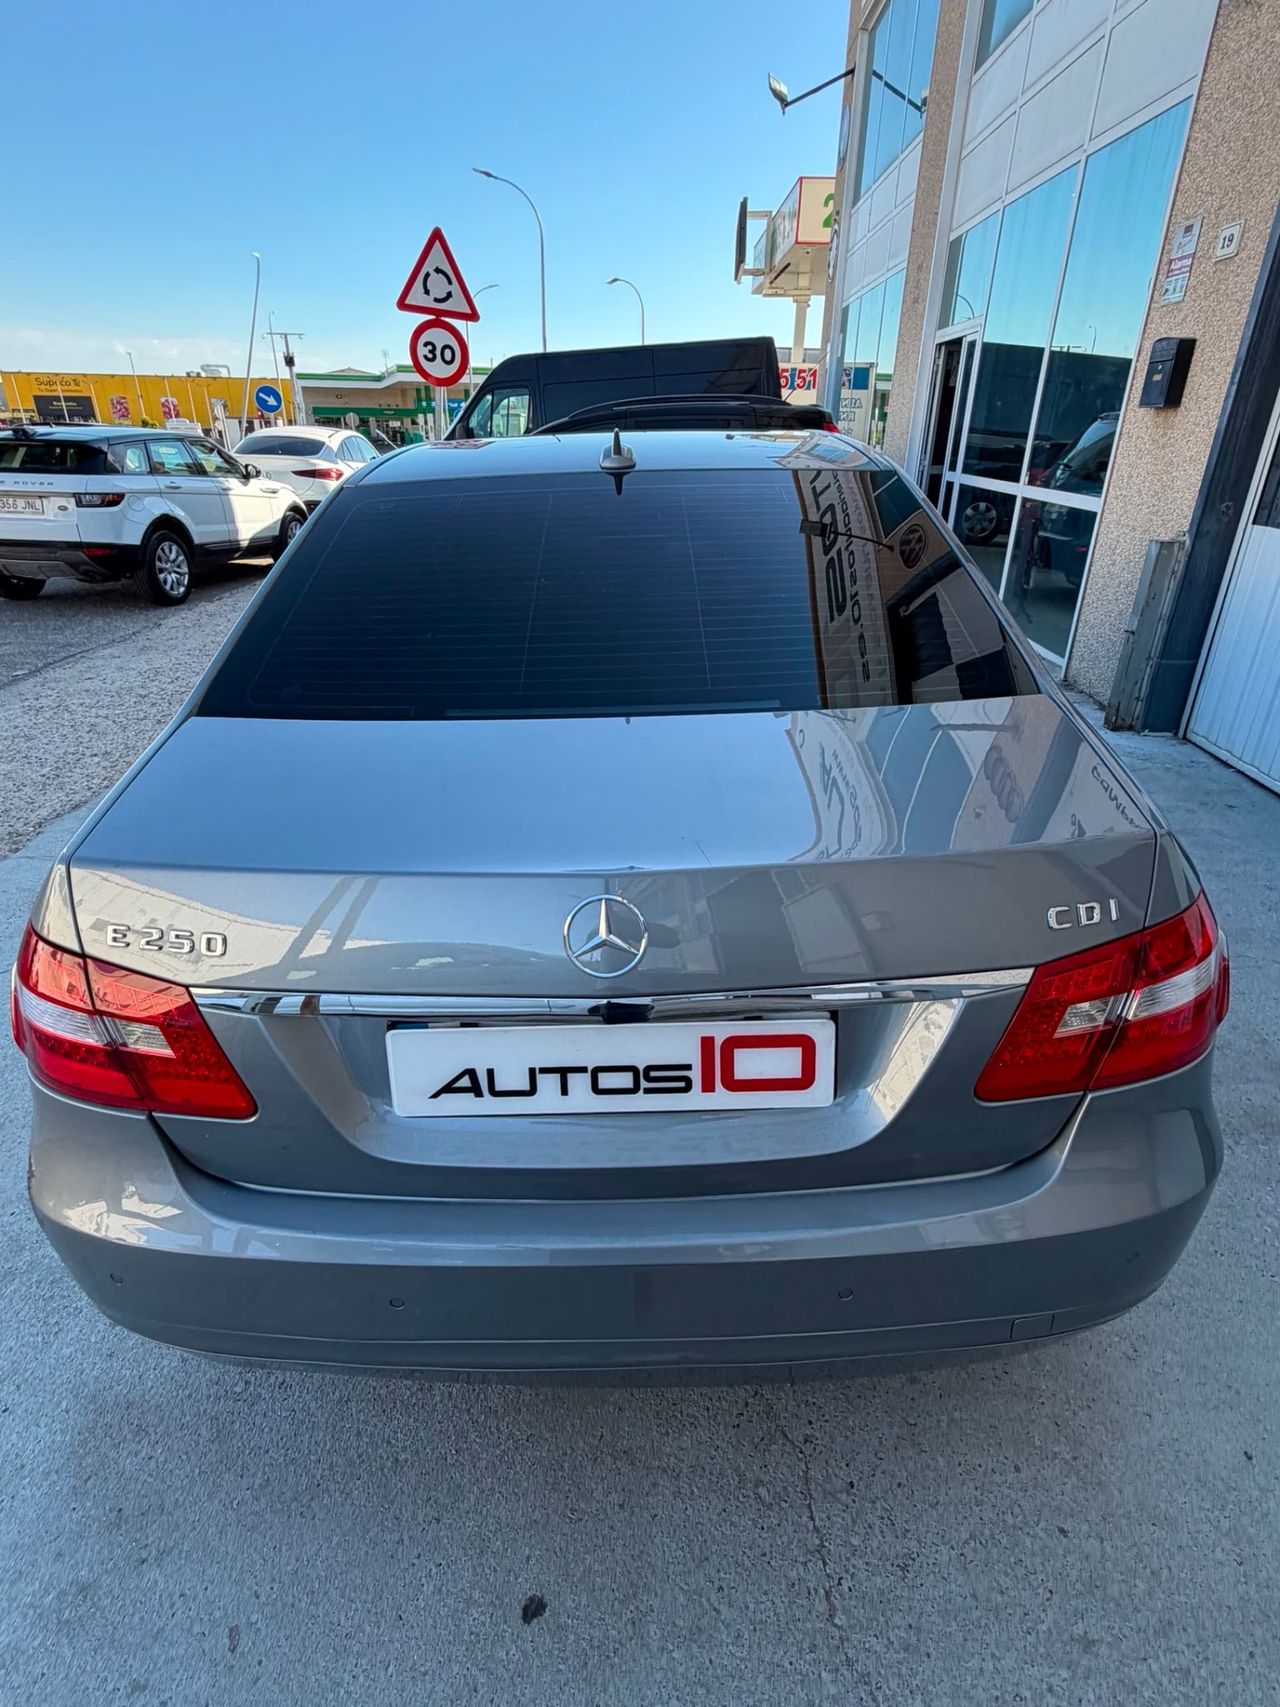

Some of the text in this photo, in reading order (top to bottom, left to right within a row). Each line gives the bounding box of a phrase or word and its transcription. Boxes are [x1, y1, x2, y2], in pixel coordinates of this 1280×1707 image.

[1220, 232, 1235, 250] 19
[422, 340, 456, 366] 30
[1047, 898, 1121, 929] CDI
[106, 923, 228, 957] E 250
[428, 1033, 817, 1099] AUTOS10
